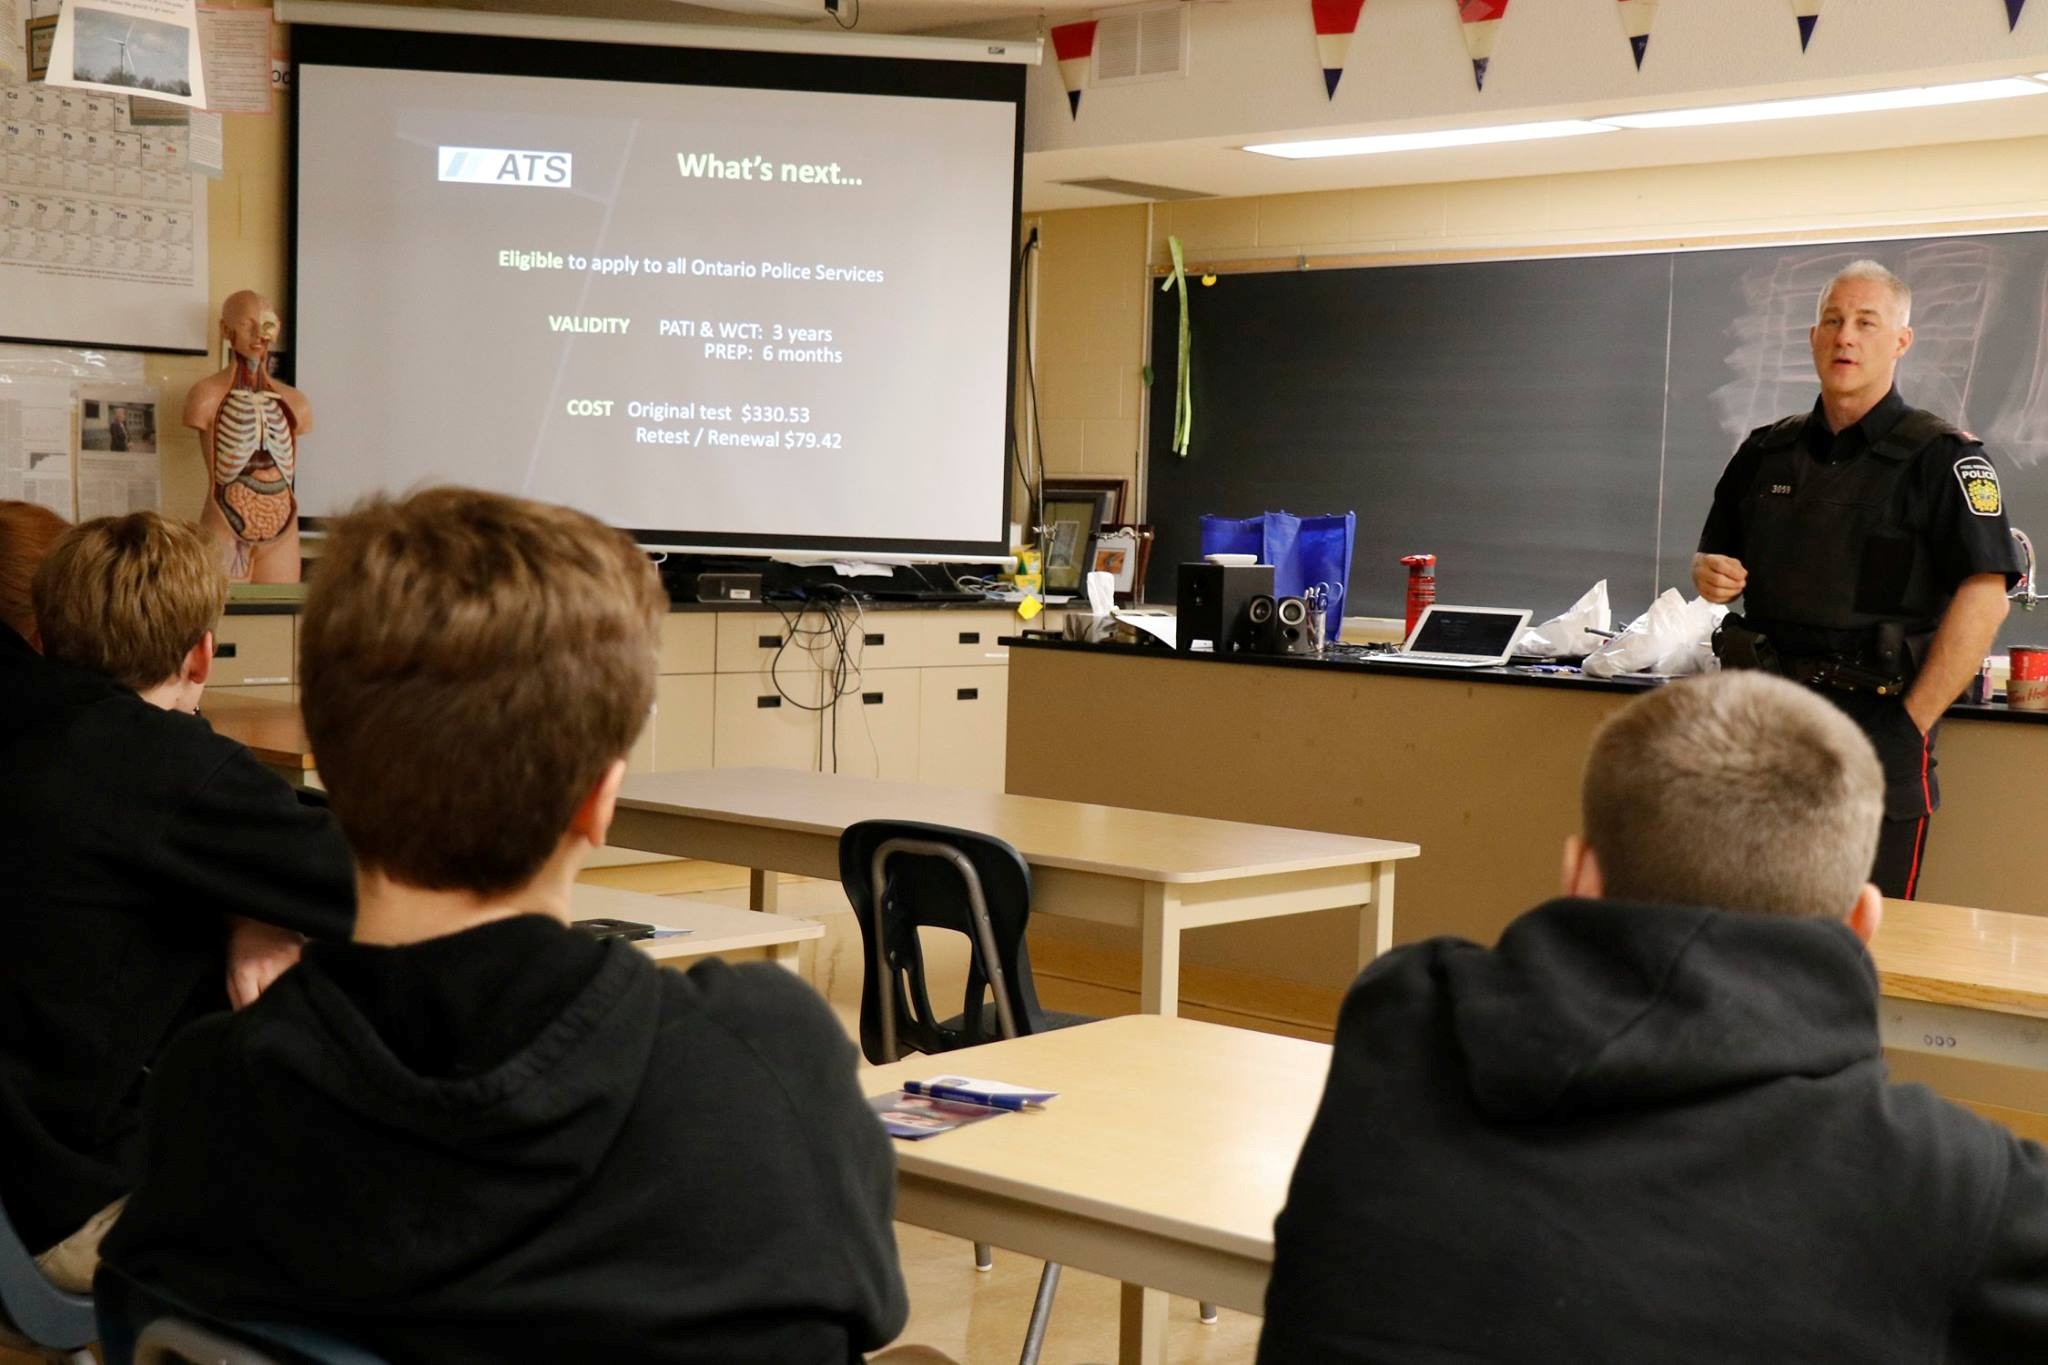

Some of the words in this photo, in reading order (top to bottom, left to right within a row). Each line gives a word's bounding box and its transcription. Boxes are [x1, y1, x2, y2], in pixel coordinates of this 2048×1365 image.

[496, 153, 568, 183] ATS
[499, 250, 564, 271] Eligible
[568, 254, 587, 271] to
[591, 255, 640, 276] apply
[643, 257, 663, 274] to
[666, 257, 687, 275] all
[691, 259, 757, 278] Ontario
[761, 262, 812, 280] Police
[815, 264, 885, 283] Services
[548, 315, 631, 335] VALIDITY
[659, 319, 695, 337] PATI
[700, 321, 714, 338] &
[719, 321, 763, 340] WCT:
[773, 323, 783, 341] 3
[787, 327, 833, 345] years
[704, 342, 753, 360] PREP:
[762, 345, 774, 361] 6
[778, 347, 843, 364] months
[566, 399, 614, 416] COST
[628, 401, 695, 422] Original
[700, 404, 732, 421] test
[741, 403, 810, 424] $330.53
[636, 427, 690, 445] Retest
[694, 427, 704, 448] /
[708, 429, 780, 448] Renewal
[784, 430, 842, 450] $79.42
[1961, 470, 1997, 481] POLICE
